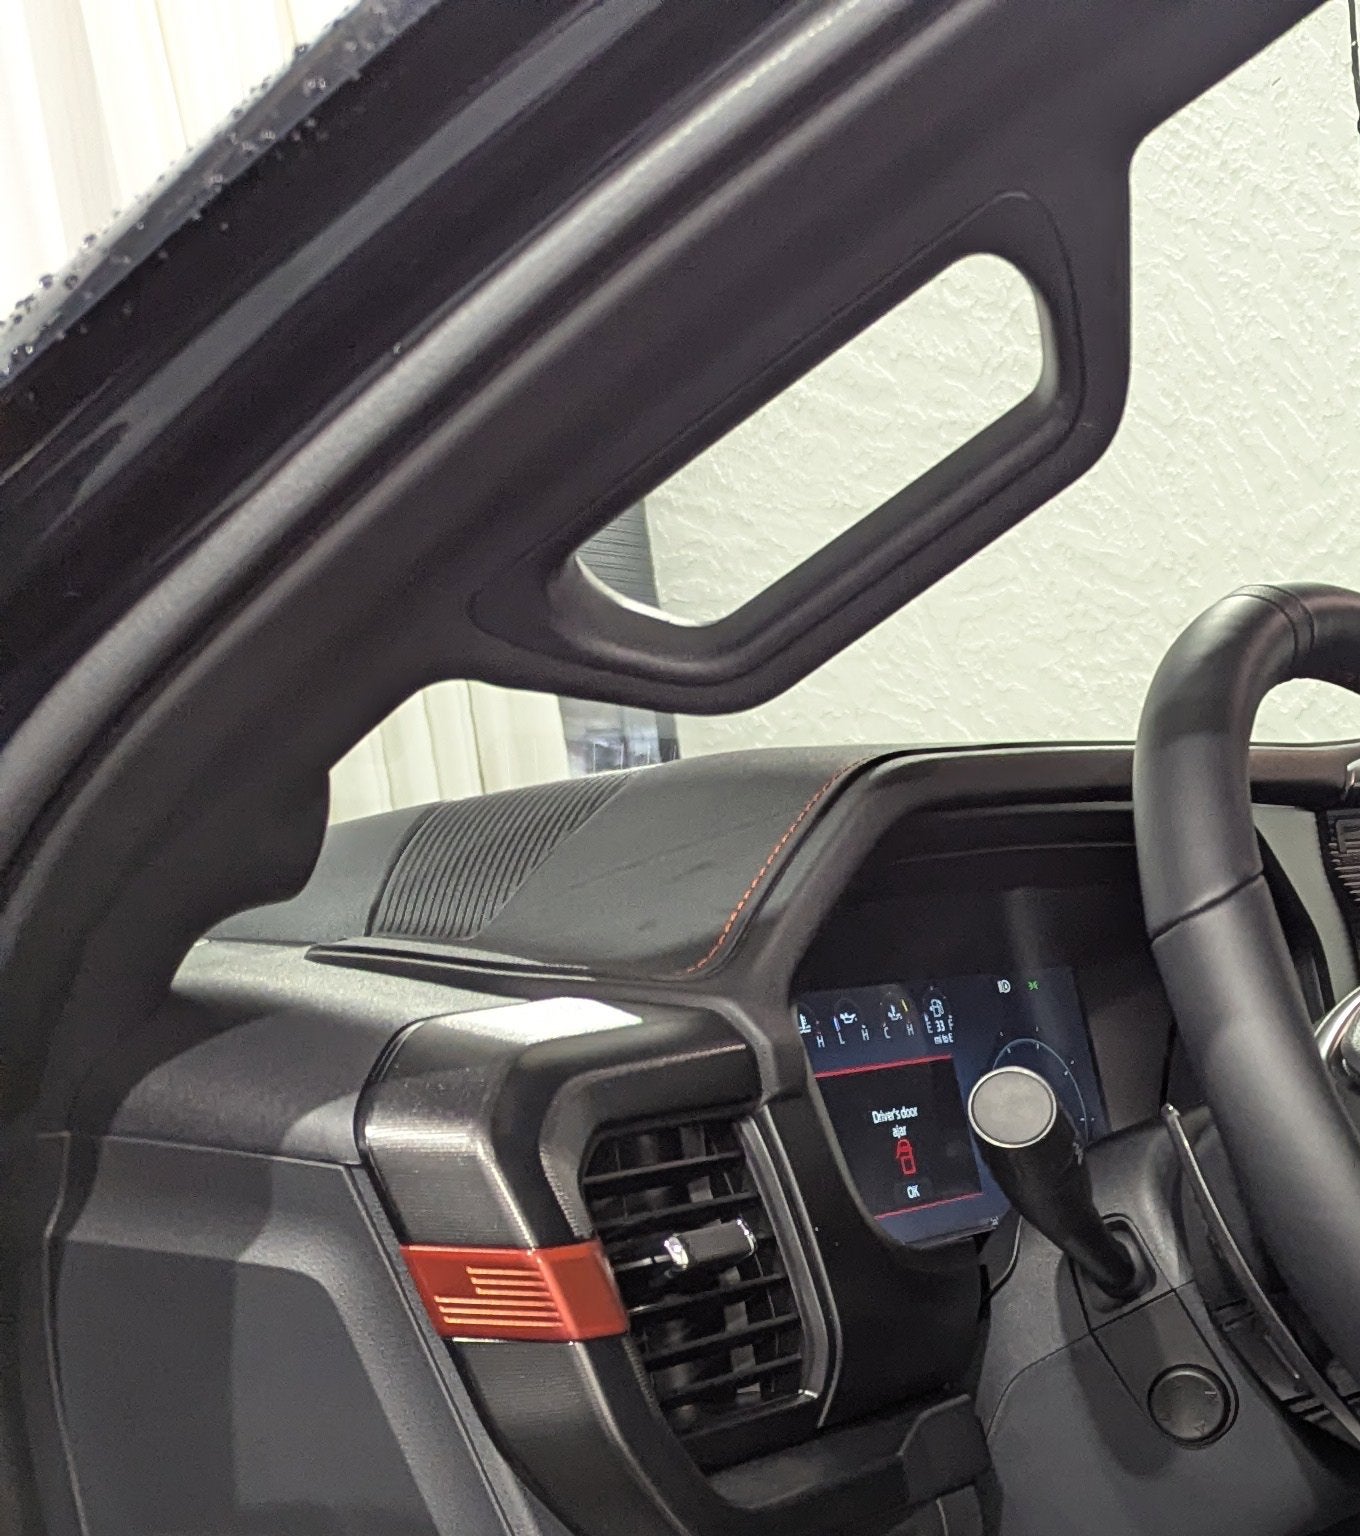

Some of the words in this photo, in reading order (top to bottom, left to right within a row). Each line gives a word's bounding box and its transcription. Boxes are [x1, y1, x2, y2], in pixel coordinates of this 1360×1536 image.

[872, 1107, 901, 1124] Driver's
[900, 1105, 918, 1120] door
[892, 1124, 907, 1139] ajar
[906, 1185, 921, 1199] OK
